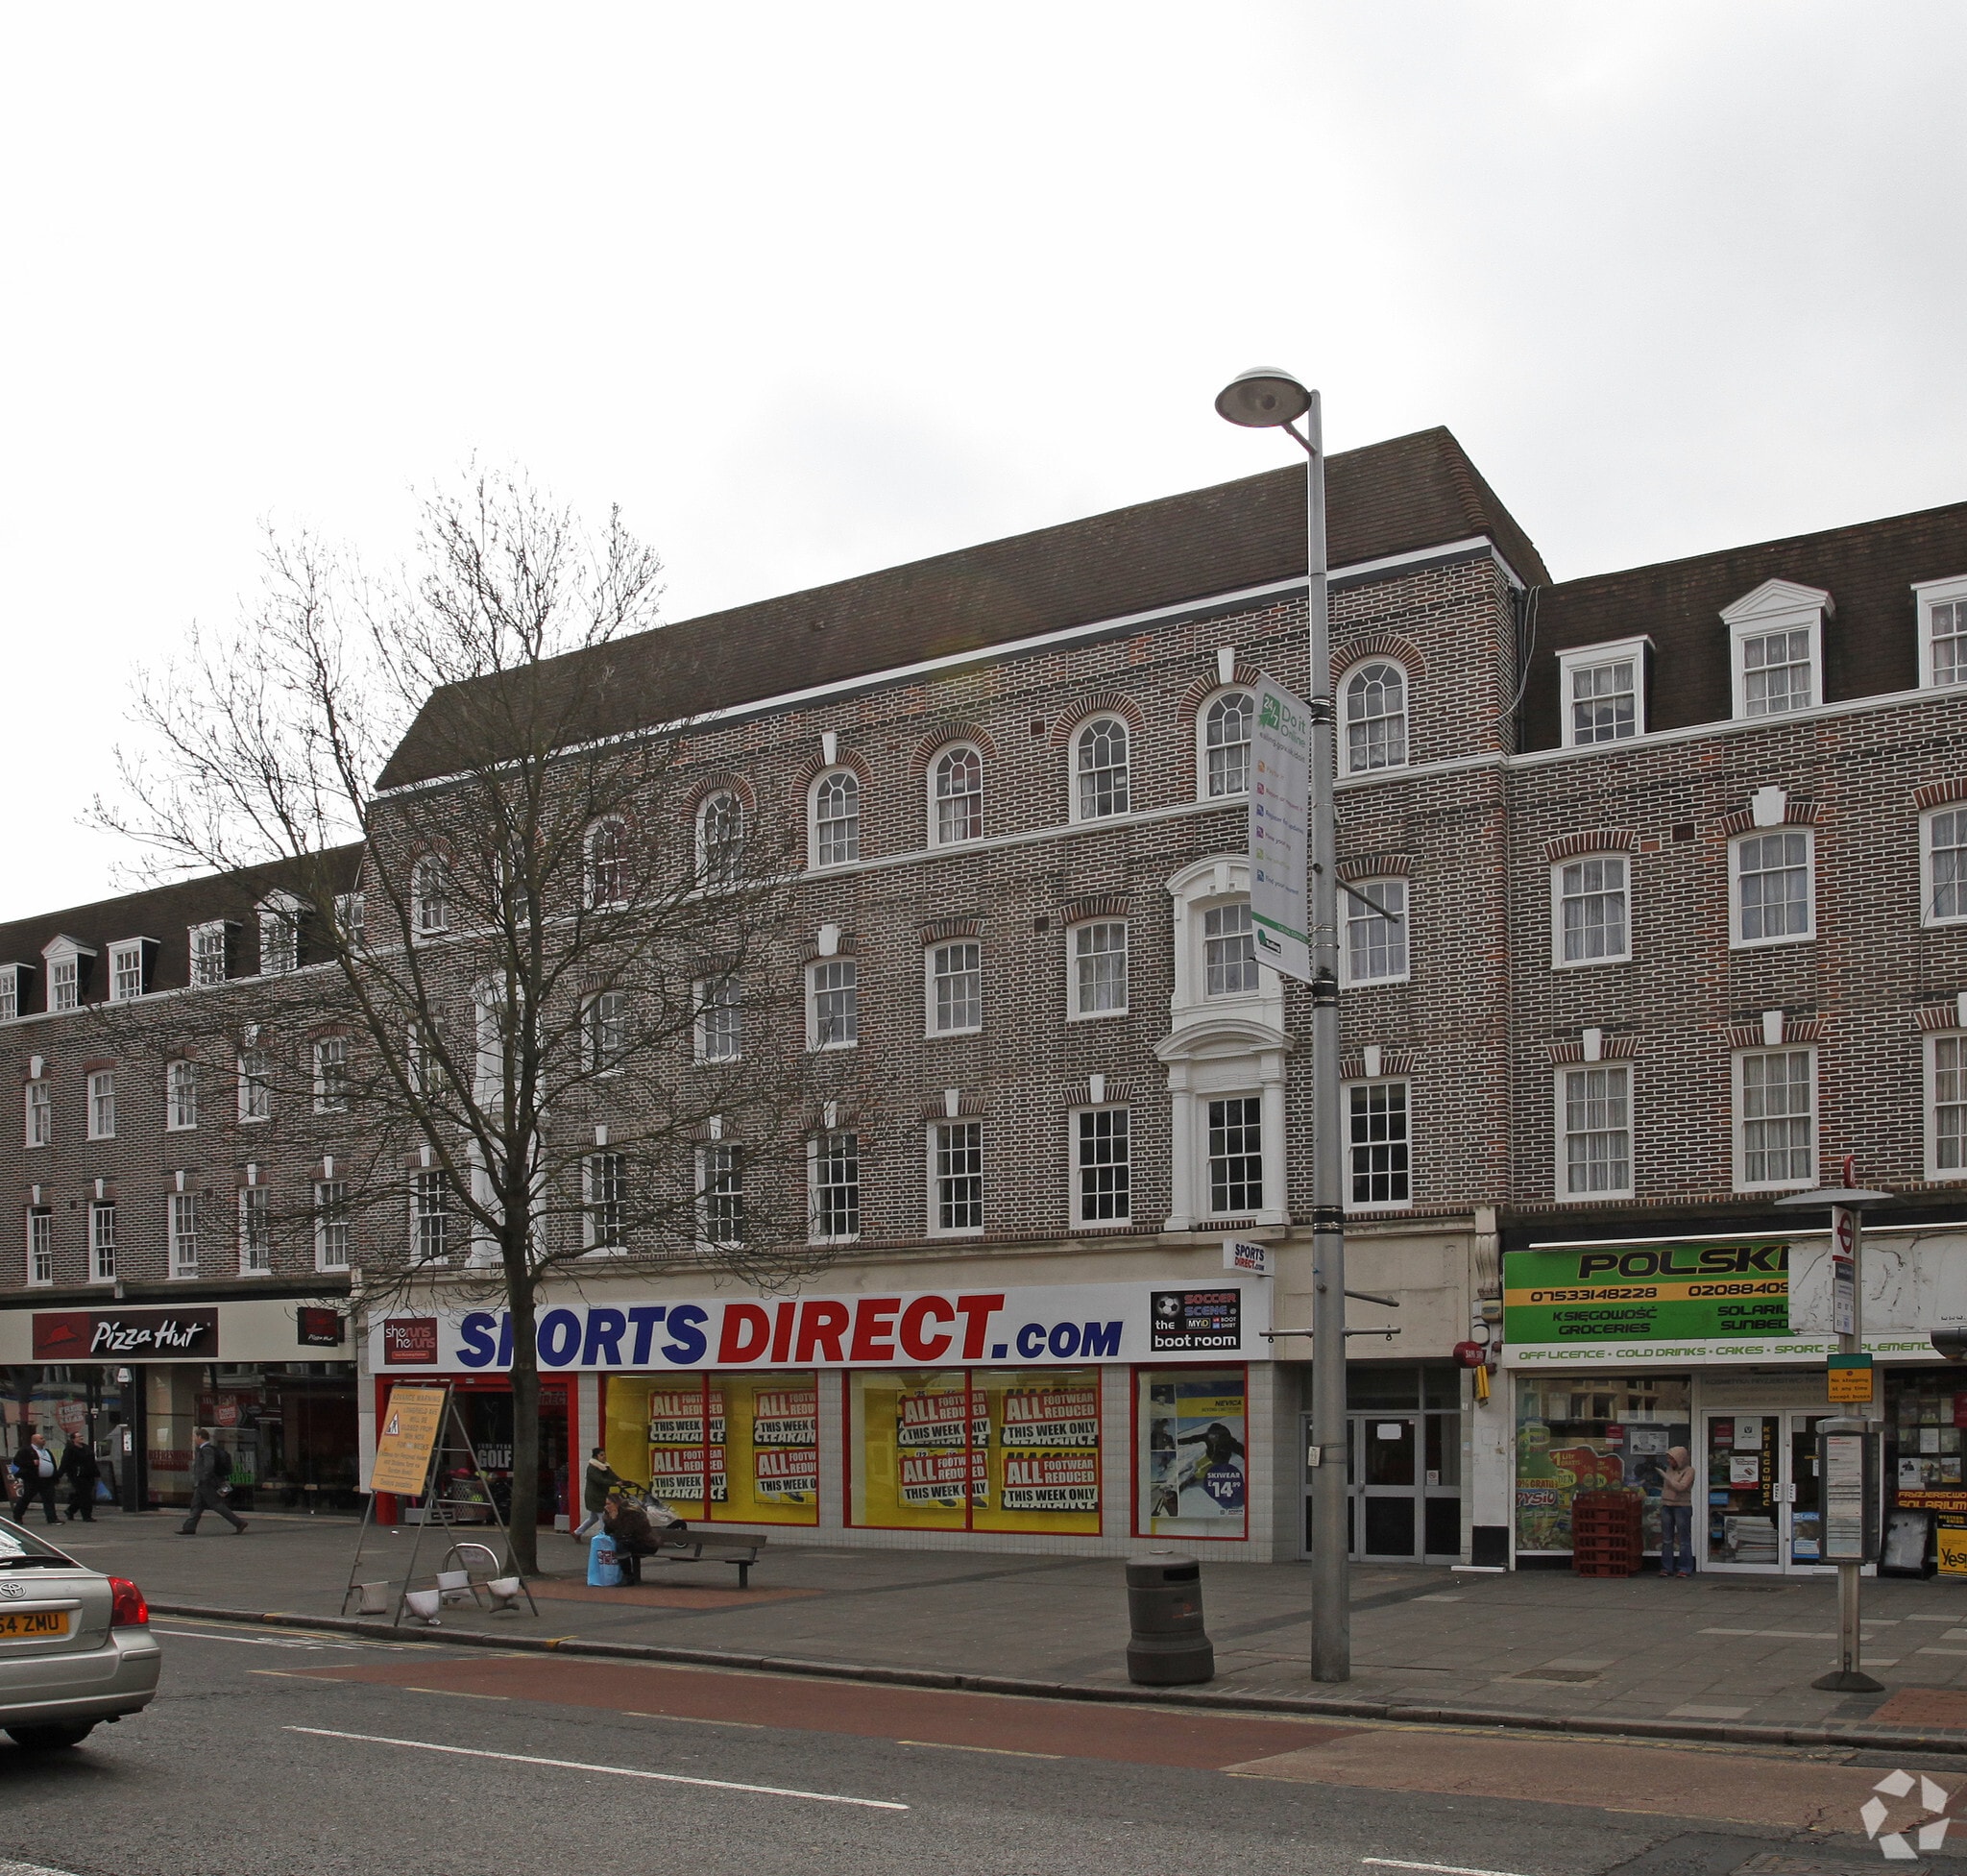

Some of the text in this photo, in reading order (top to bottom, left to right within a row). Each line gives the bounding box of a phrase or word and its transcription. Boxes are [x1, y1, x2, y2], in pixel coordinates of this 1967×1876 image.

[1282, 705, 1306, 734] Do it
[1281, 724, 1306, 748] Online
[1235, 1243, 1264, 1262] SPORTS
[1184, 1293, 1236, 1304] SOCCER
[1531, 1288, 1657, 1303] 07533148228
[1184, 1305, 1227, 1316] SCENE
[1553, 1306, 1658, 1322] KSIĘGOWOŚĆ
[1155, 1320, 1175, 1330] the
[1558, 1323, 1651, 1335] GROCERIES
[1720, 1319, 1788, 1330] SUNBED
[90, 1319, 203, 1352] Pizza Hut
[1155, 1334, 1236, 1347] boot room
[1519, 1351, 1547, 1360] OFF
[1548, 1349, 1605, 1359] LICENCE
[1616, 1348, 1654, 1358] COLD
[1655, 1347, 1706, 1357] DRINKS
[1716, 1345, 1764, 1355] CAKES
[1774, 1345, 1824, 1354] SPORT
[653, 1394, 682, 1416] ALL
[759, 1394, 789, 1416] ALL
[905, 1399, 938, 1423] ALL
[1007, 1393, 1093, 1421] ALL FOOTWEAR
[1045, 1404, 1094, 1418] REDUCED
[654, 1421, 674, 1431] THIS
[676, 1420, 700, 1431] WEEK
[761, 1422, 781, 1433] THIS
[782, 1420, 808, 1432] WEEK
[907, 1427, 930, 1440] THIS
[932, 1424, 960, 1437] WEEK
[1008, 1422, 1095, 1438] THIS WEEK ONLY
[478, 1449, 512, 1468] GOLF
[653, 1451, 682, 1473] ALL
[758, 1453, 789, 1476] ALL
[904, 1459, 937, 1483] ALL
[1008, 1459, 1093, 1484] ALL FOOTWEAR
[1044, 1471, 1094, 1483] REDUCED
[655, 1478, 675, 1488] THIS
[676, 1476, 701, 1487] WEEK
[761, 1481, 781, 1492] THIS
[782, 1479, 808, 1490] WEEK
[905, 1487, 929, 1499] THIS
[931, 1485, 959, 1498] WEEK
[1008, 1488, 1095, 1502] THIS WEEK ONLY
[24, 1615, 59, 1632] ZMU
